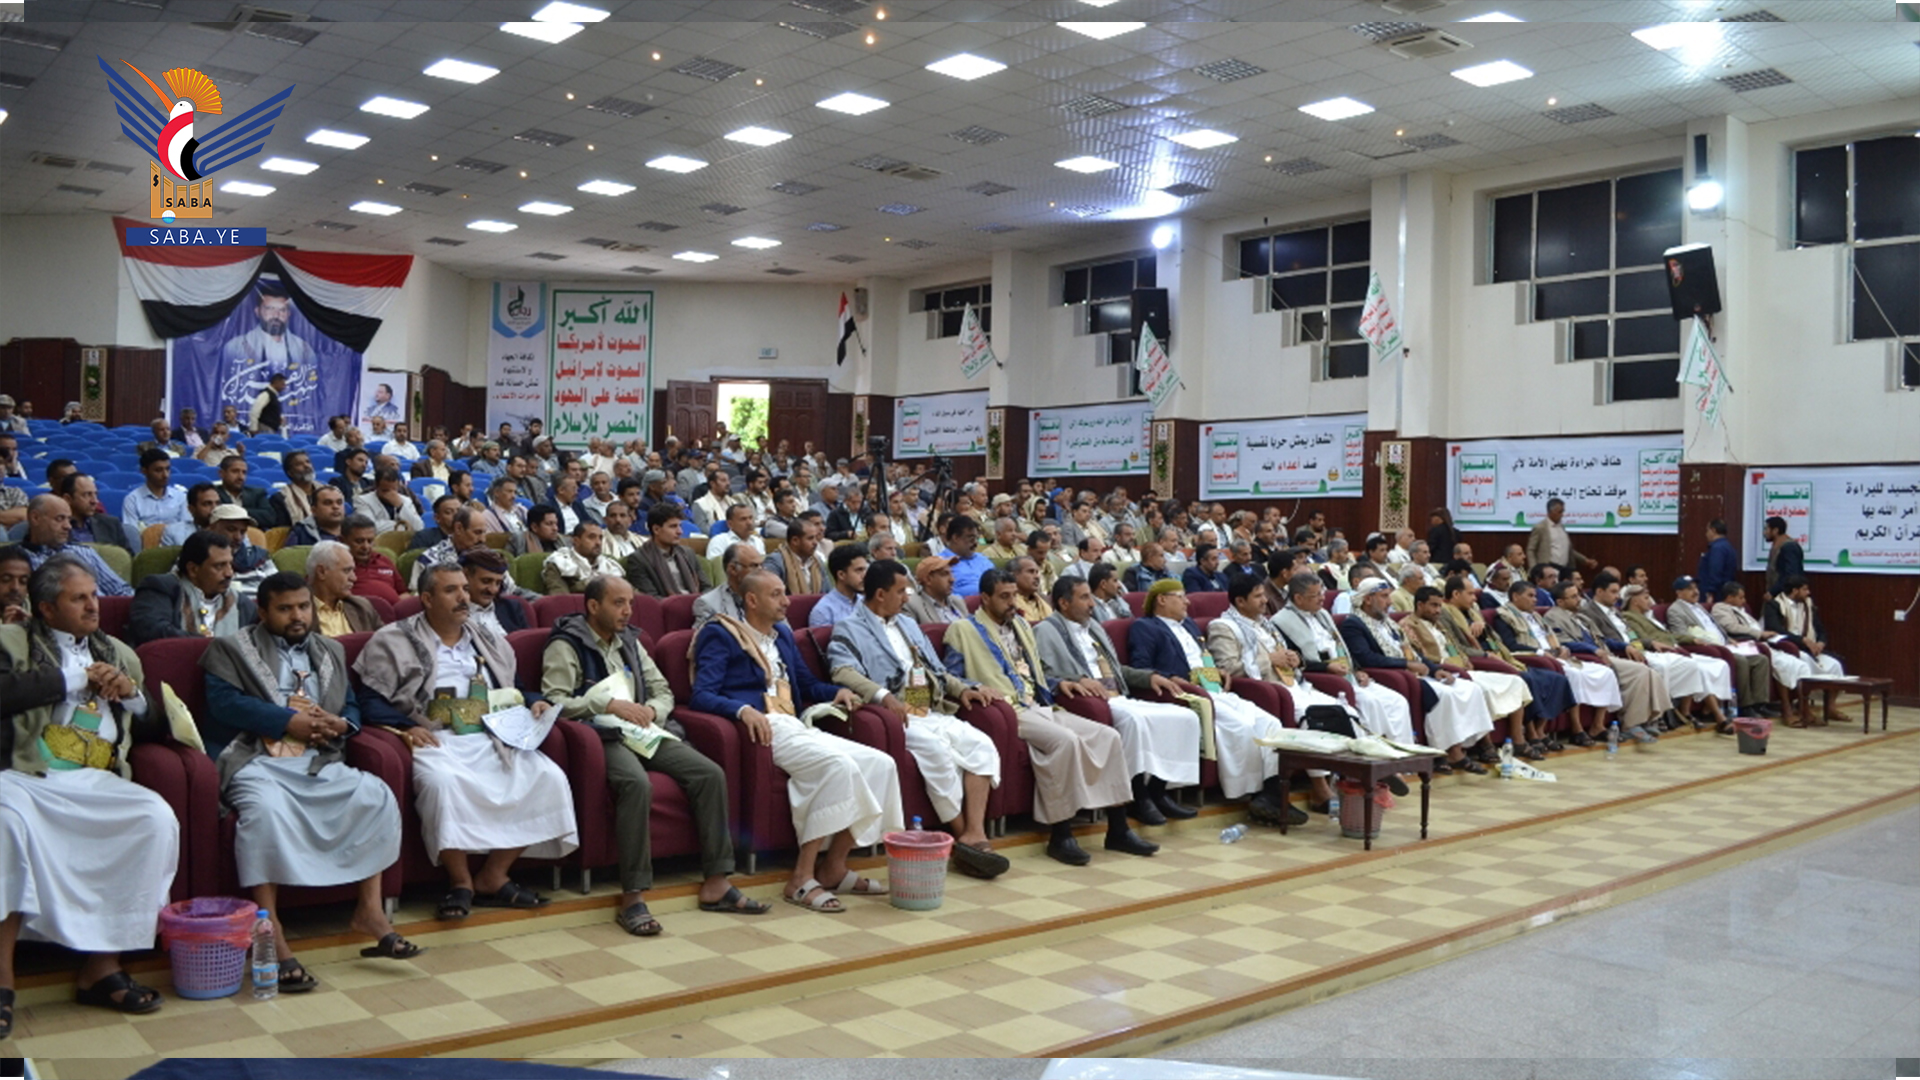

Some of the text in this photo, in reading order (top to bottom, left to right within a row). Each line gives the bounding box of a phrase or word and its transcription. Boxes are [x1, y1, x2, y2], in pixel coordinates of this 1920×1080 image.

[558, 296, 613, 331] أكبر
[614, 300, 648, 324] الله
[607, 335, 646, 354] الموت
[606, 362, 645, 381] الموت
[554, 386, 644, 407] اللعنة على اليهود
[554, 410, 644, 440] النصر للإسلام
[1246, 436, 1268, 451] نفسية
[1310, 432, 1334, 448] الشعار
[1262, 456, 1317, 470] ضد أعداء الله
[1512, 457, 1524, 472] لأي
[1528, 457, 1548, 468] الأمة
[1570, 456, 1598, 470] البراءة
[1642, 452, 1666, 466] أكبر
[1506, 484, 1627, 500] موقف تحتاج إليه لمواجهة العدو
[1766, 488, 1809, 502] قاطعوا
[1846, 482, 1884, 498] للبراءة
[1862, 500, 1918, 520] أمر الله بها
[1855, 525, 1892, 541] الكريم
